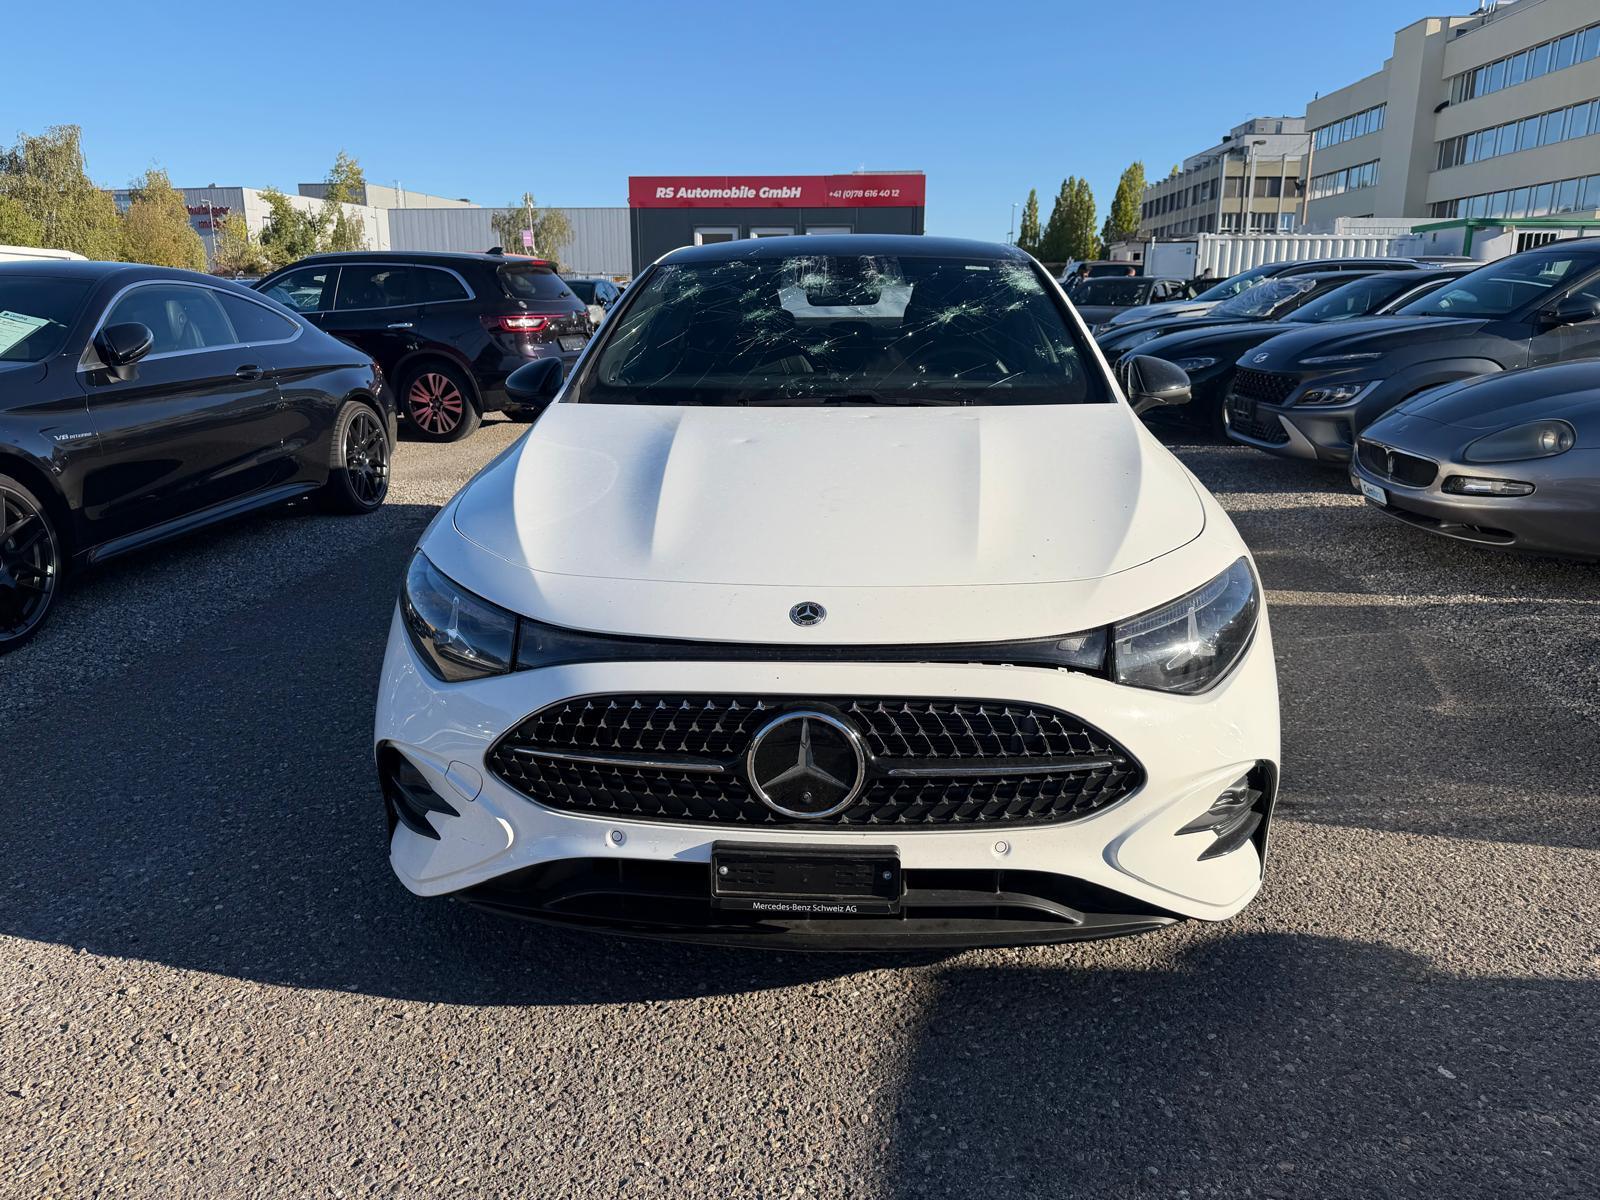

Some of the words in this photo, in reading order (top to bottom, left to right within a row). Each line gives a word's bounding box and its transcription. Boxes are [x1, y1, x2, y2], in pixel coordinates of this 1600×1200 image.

[655, 187, 674, 198] RS
[676, 185, 756, 198] Automobile
[759, 187, 801, 198] GmbH
[829, 190, 842, 198] +41
[842, 190, 863, 199] (0)78
[864, 190, 878, 198] 616
[879, 189, 890, 198] 40
[891, 189, 900, 198] 12
[752, 902, 811, 912] Mercedes-Benz
[812, 903, 844, 912] Schweiz
[845, 905, 857, 913] AG
